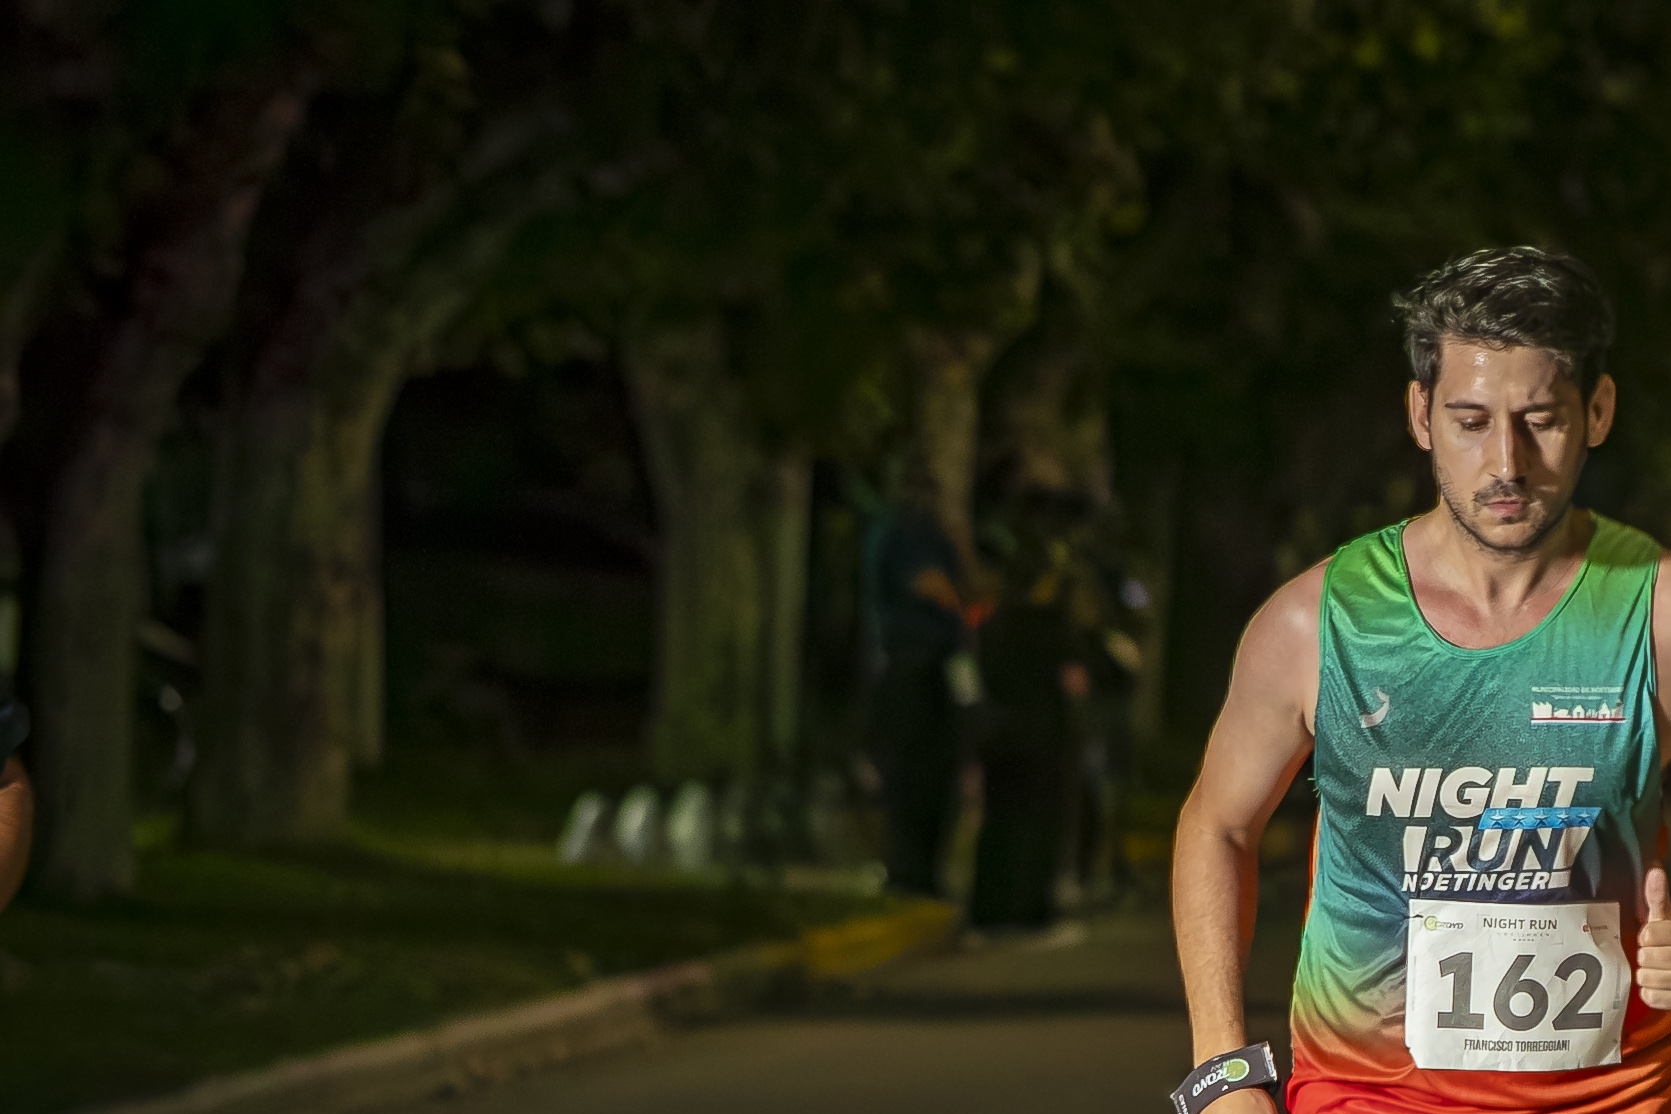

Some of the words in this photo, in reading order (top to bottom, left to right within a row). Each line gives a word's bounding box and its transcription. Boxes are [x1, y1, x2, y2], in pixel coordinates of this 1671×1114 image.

[1365, 766, 1596, 819] NIGHT
[1404, 826, 1590, 873] RUN
[1482, 917, 1526, 930] NIGHT
[1529, 918, 1558, 931] RUN
[1437, 951, 1604, 1032] 162
[1463, 1038, 1513, 1051] FRANCISCO
